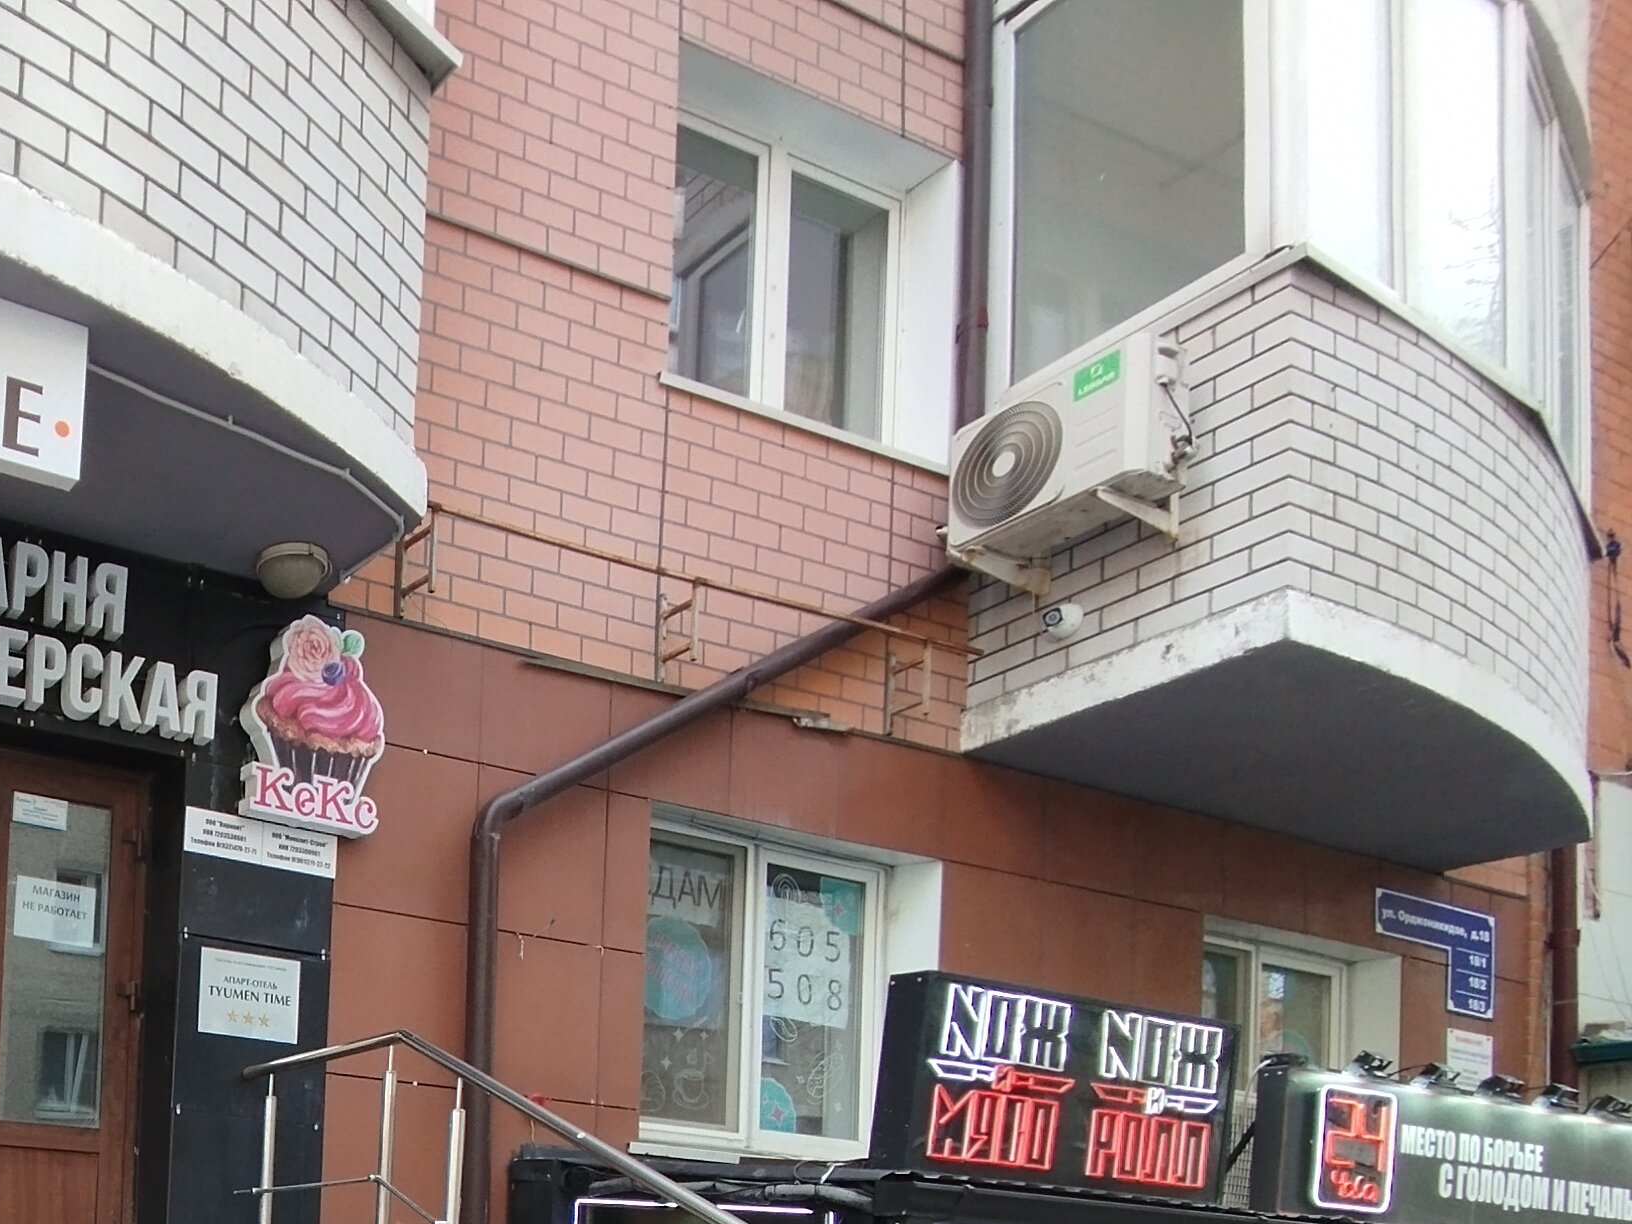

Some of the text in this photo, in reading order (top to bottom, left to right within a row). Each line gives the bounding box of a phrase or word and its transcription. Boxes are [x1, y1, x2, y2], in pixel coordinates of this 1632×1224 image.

[32, 884, 81, 902] МАГАЗИН
[648, 865, 724, 910] ДАМ
[22, 901, 88, 921] НЕ РАБОТАЕТ
[1381, 907, 1397, 920] ул.
[1398, 910, 1468, 939] Орджоникидзе,
[208, 985, 291, 1006] TYUMEN TIME
[223, 975, 278, 990] АПАРТ-ОТЕЛЬ
[1326, 1096, 1389, 1173] 24
[1400, 1124, 1544, 1173] МЕСТО ПО БОРЬБЕ
[1438, 1163, 1454, 1199] С
[1456, 1165, 1551, 1213] ГОЛОДОМ
[1552, 1177, 1567, 1212] И
